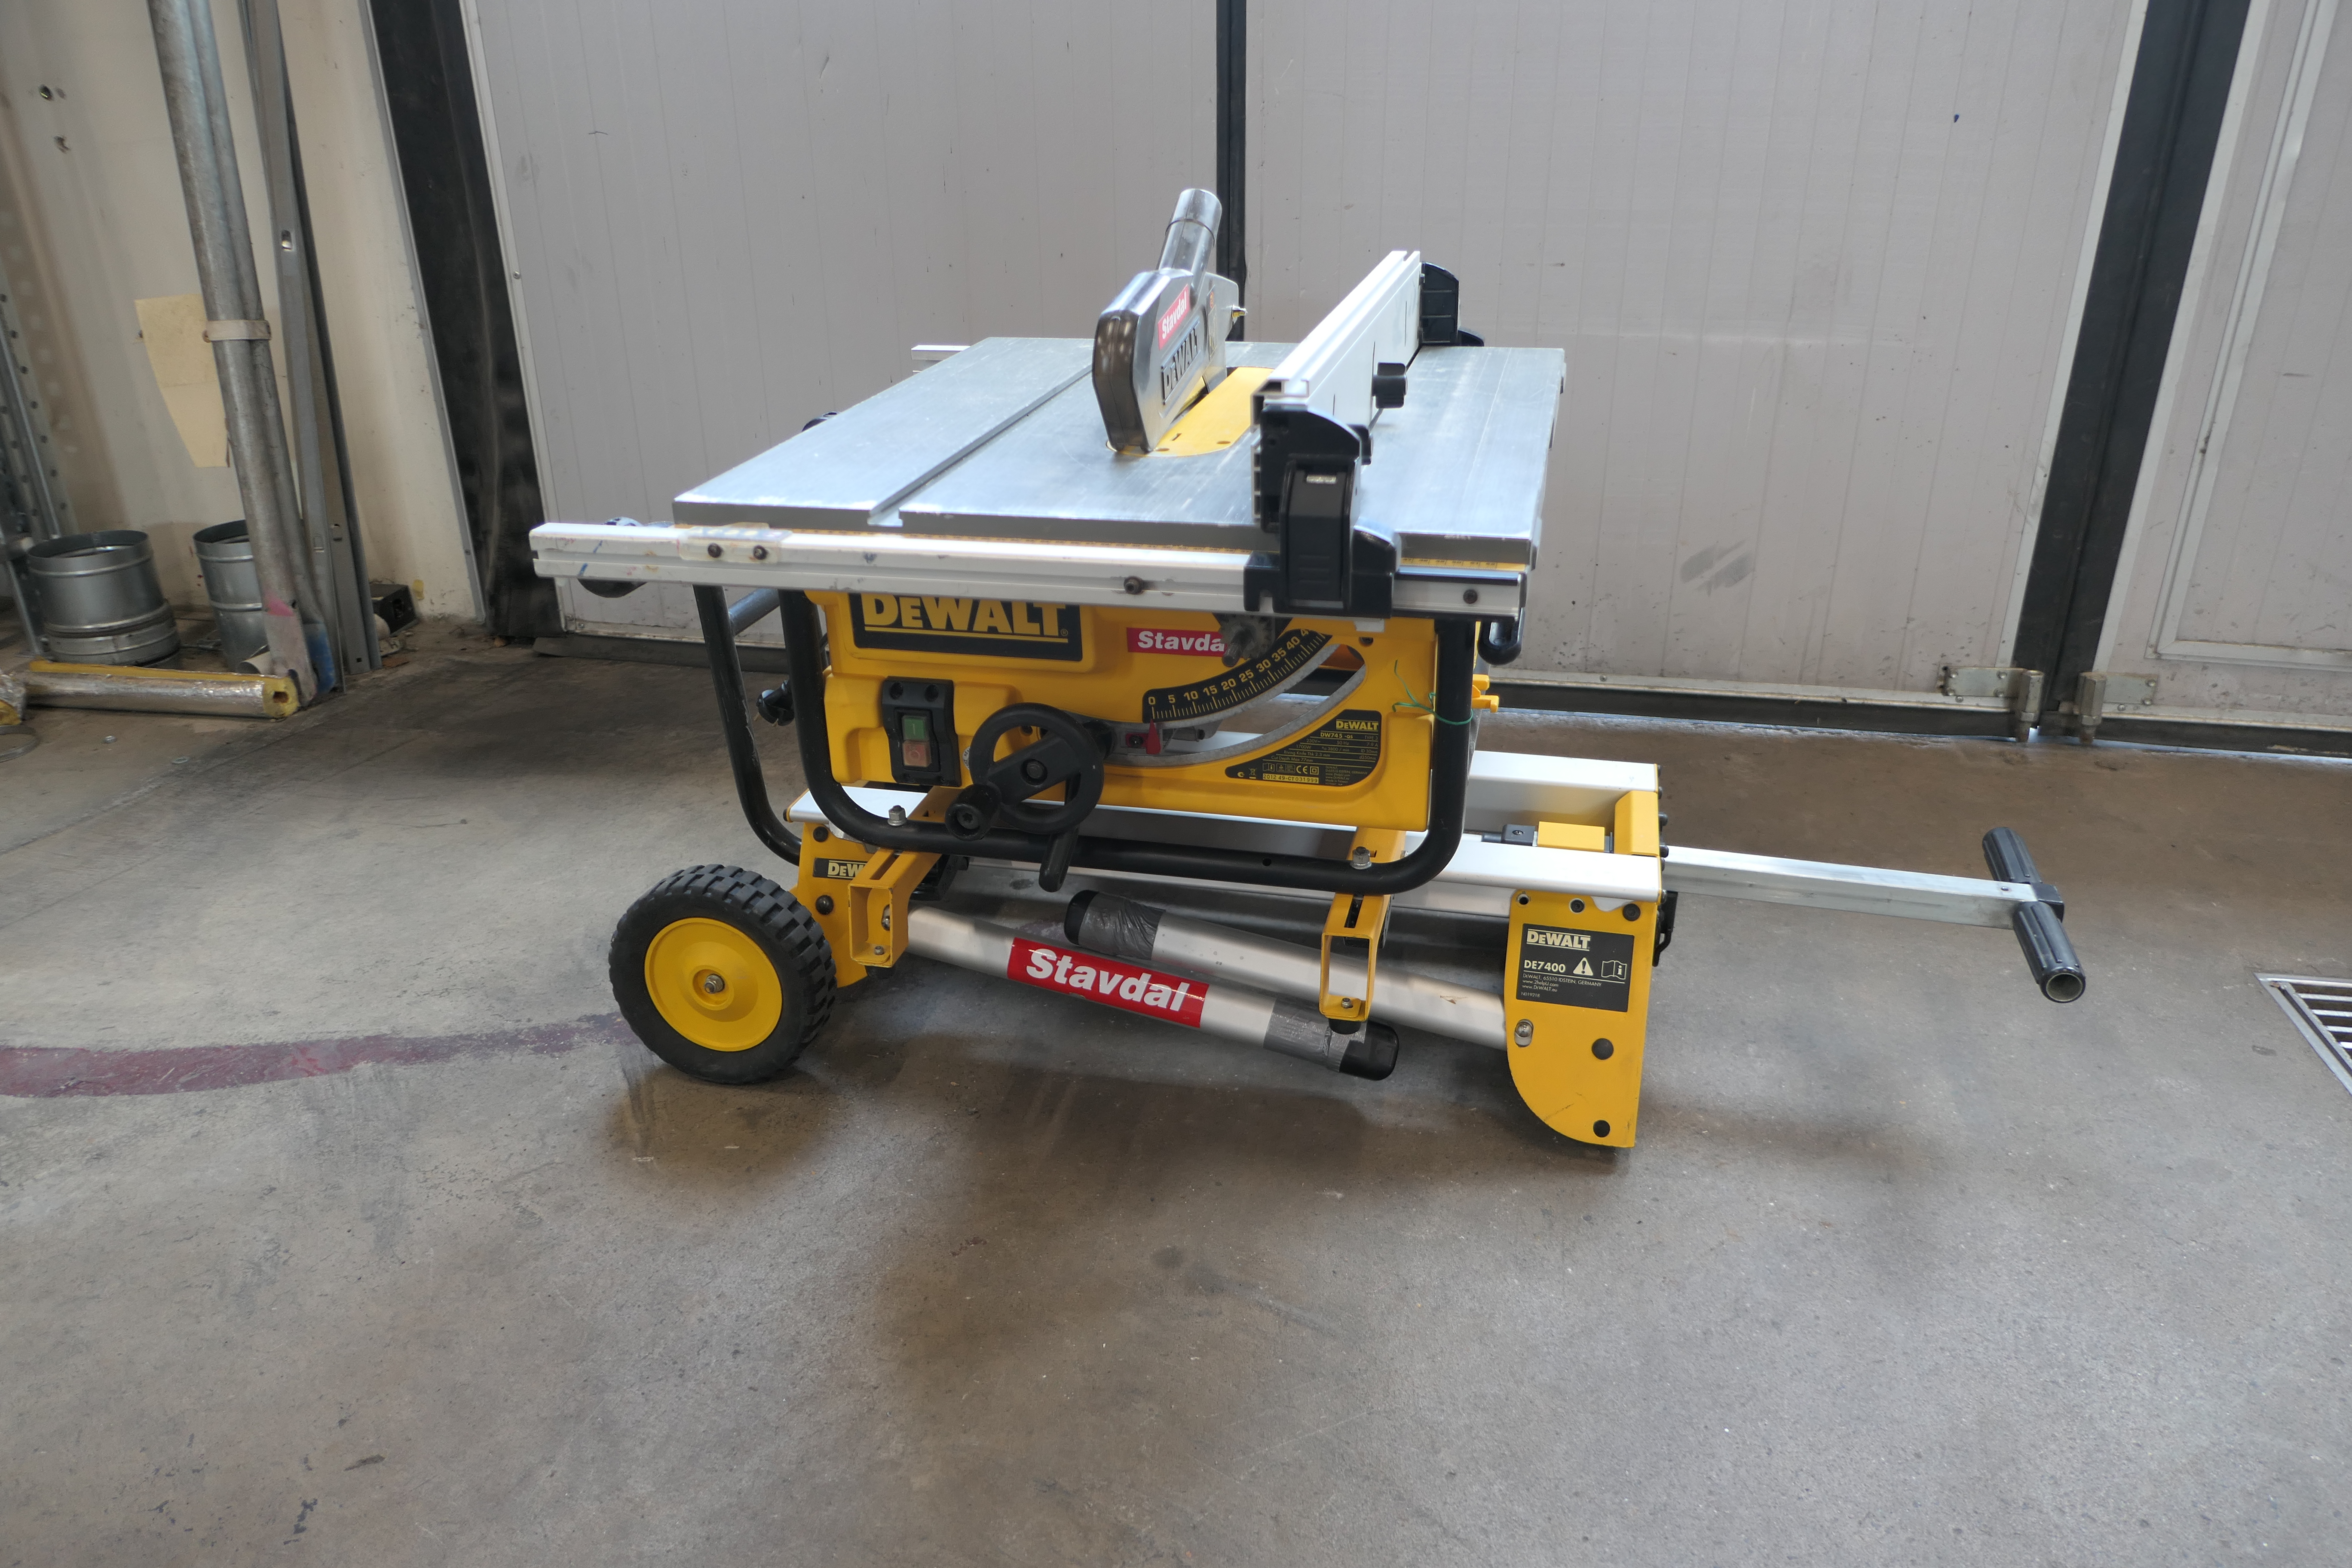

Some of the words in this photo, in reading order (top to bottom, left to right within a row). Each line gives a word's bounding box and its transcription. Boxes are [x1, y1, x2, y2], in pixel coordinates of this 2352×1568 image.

[1162, 291, 1187, 339] Stavdal
[1138, 631, 1225, 652] Stavda
[1148, 696, 1156, 705] 0
[1168, 695, 1176, 704] 5
[1184, 691, 1198, 701] 10
[1203, 685, 1218, 696] 15
[1221, 678, 1236, 690] 20
[1239, 669, 1254, 683] 25
[1256, 661, 1271, 673] 30
[1271, 649, 1286, 662] 35
[1286, 636, 1300, 650] 40
[1301, 629, 1309, 637] 4
[1026, 948, 1190, 1012] Stavdal
[1524, 959, 1566, 973] DE7400
